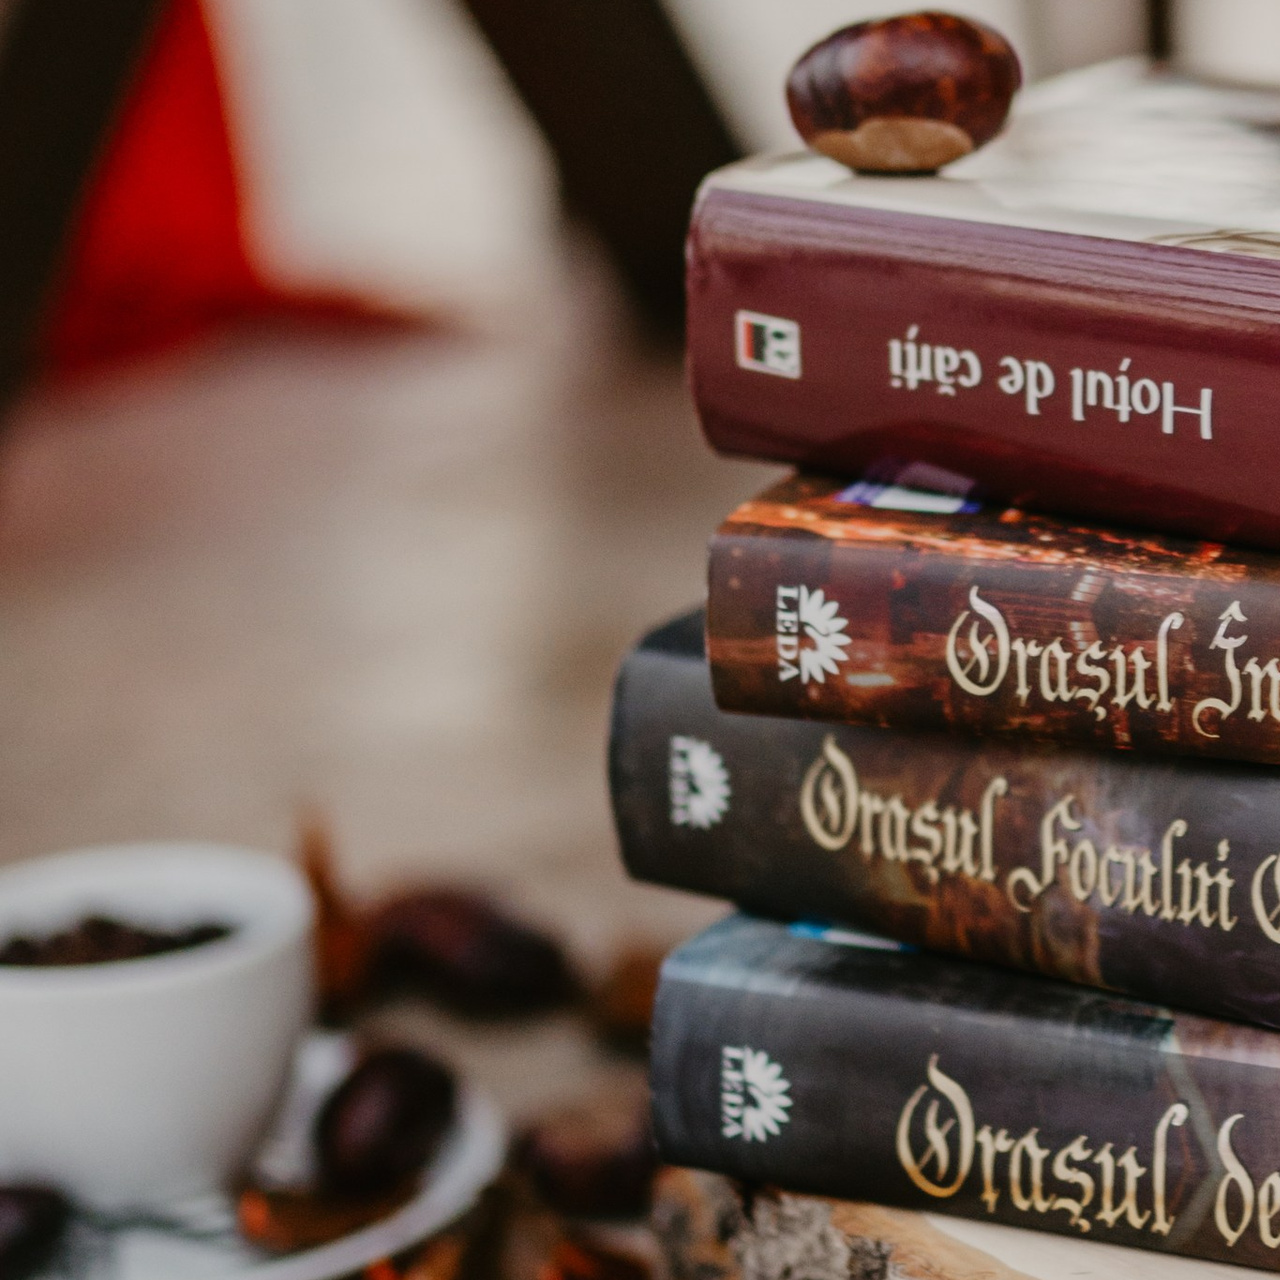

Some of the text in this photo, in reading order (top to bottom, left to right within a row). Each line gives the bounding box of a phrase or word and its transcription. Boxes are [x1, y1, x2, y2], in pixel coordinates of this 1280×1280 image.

[888, 323, 1213, 440] Hoțul de cărți
[775, 585, 801, 683] LEDA
[944, 584, 1185, 721] Orașul
[799, 733, 1009, 885] Orașul
[1006, 793, 1239, 933] Focului
[895, 1052, 1189, 1236] Orașul
